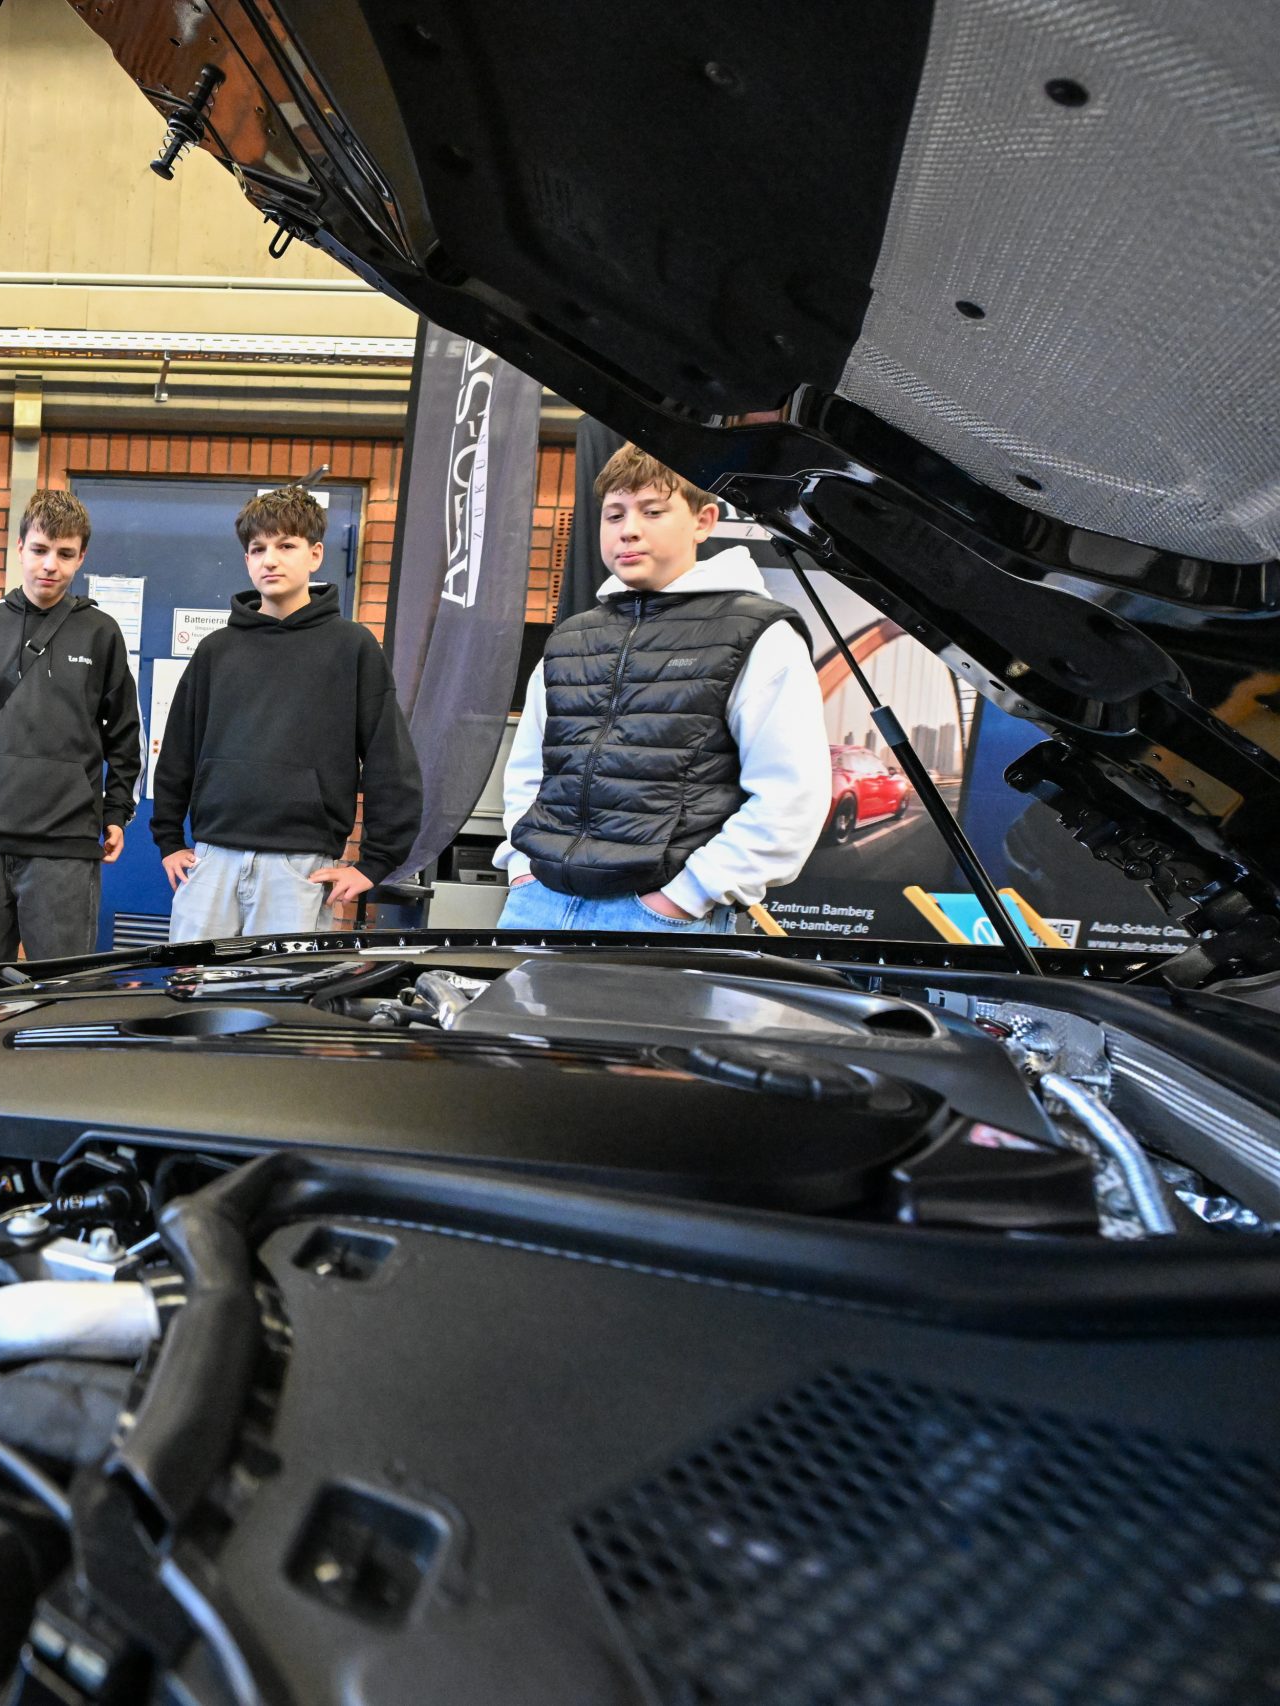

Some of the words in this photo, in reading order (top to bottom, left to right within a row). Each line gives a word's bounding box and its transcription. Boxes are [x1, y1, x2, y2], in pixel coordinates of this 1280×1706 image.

[770, 901, 820, 915] Zentrum
[822, 904, 875, 920] Bamberg
[1089, 921, 1162, 936] Auto-Scholz
